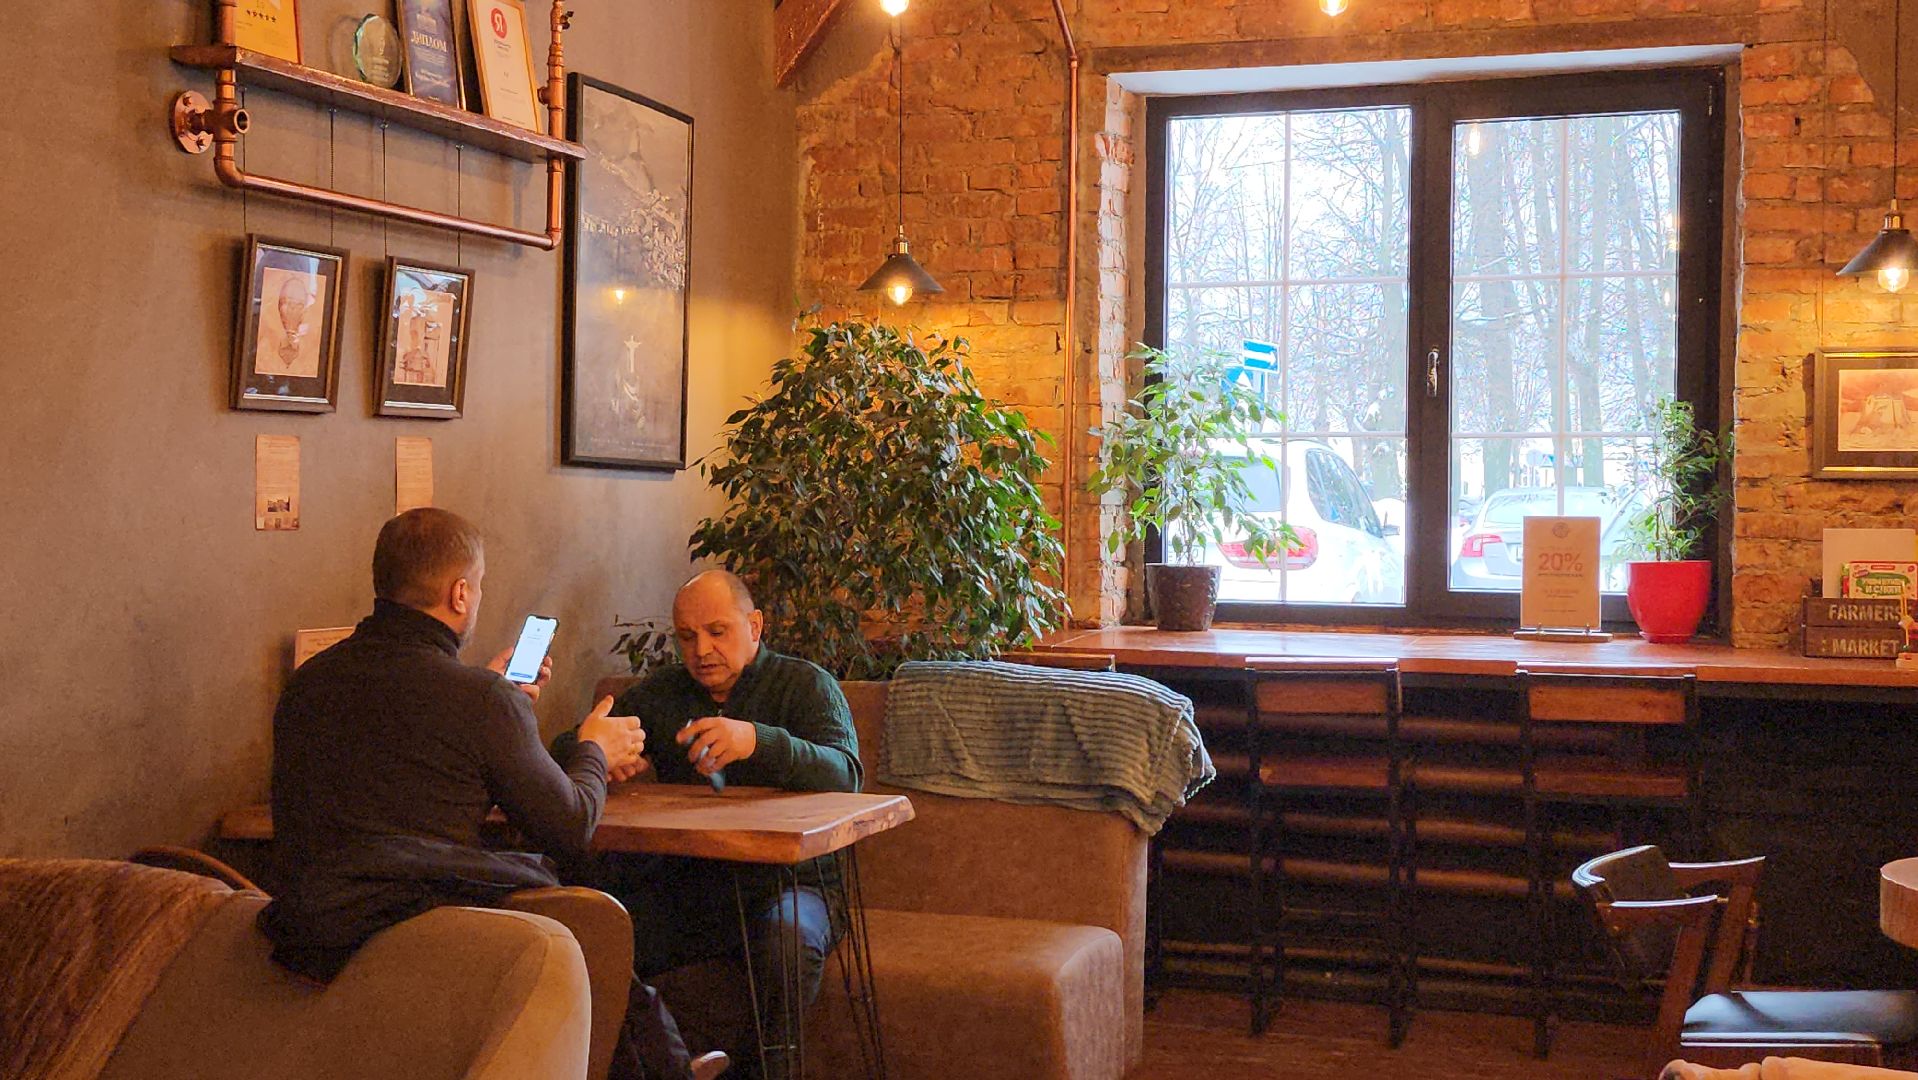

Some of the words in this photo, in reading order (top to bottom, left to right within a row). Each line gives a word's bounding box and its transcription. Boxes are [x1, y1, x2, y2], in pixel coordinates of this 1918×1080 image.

[411, 30, 448, 53] ДИПЛОМ
[1538, 552, 1584, 572] 20%
[1828, 604, 1902, 621] FARMERS
[1832, 639, 1899, 656] MARKET
